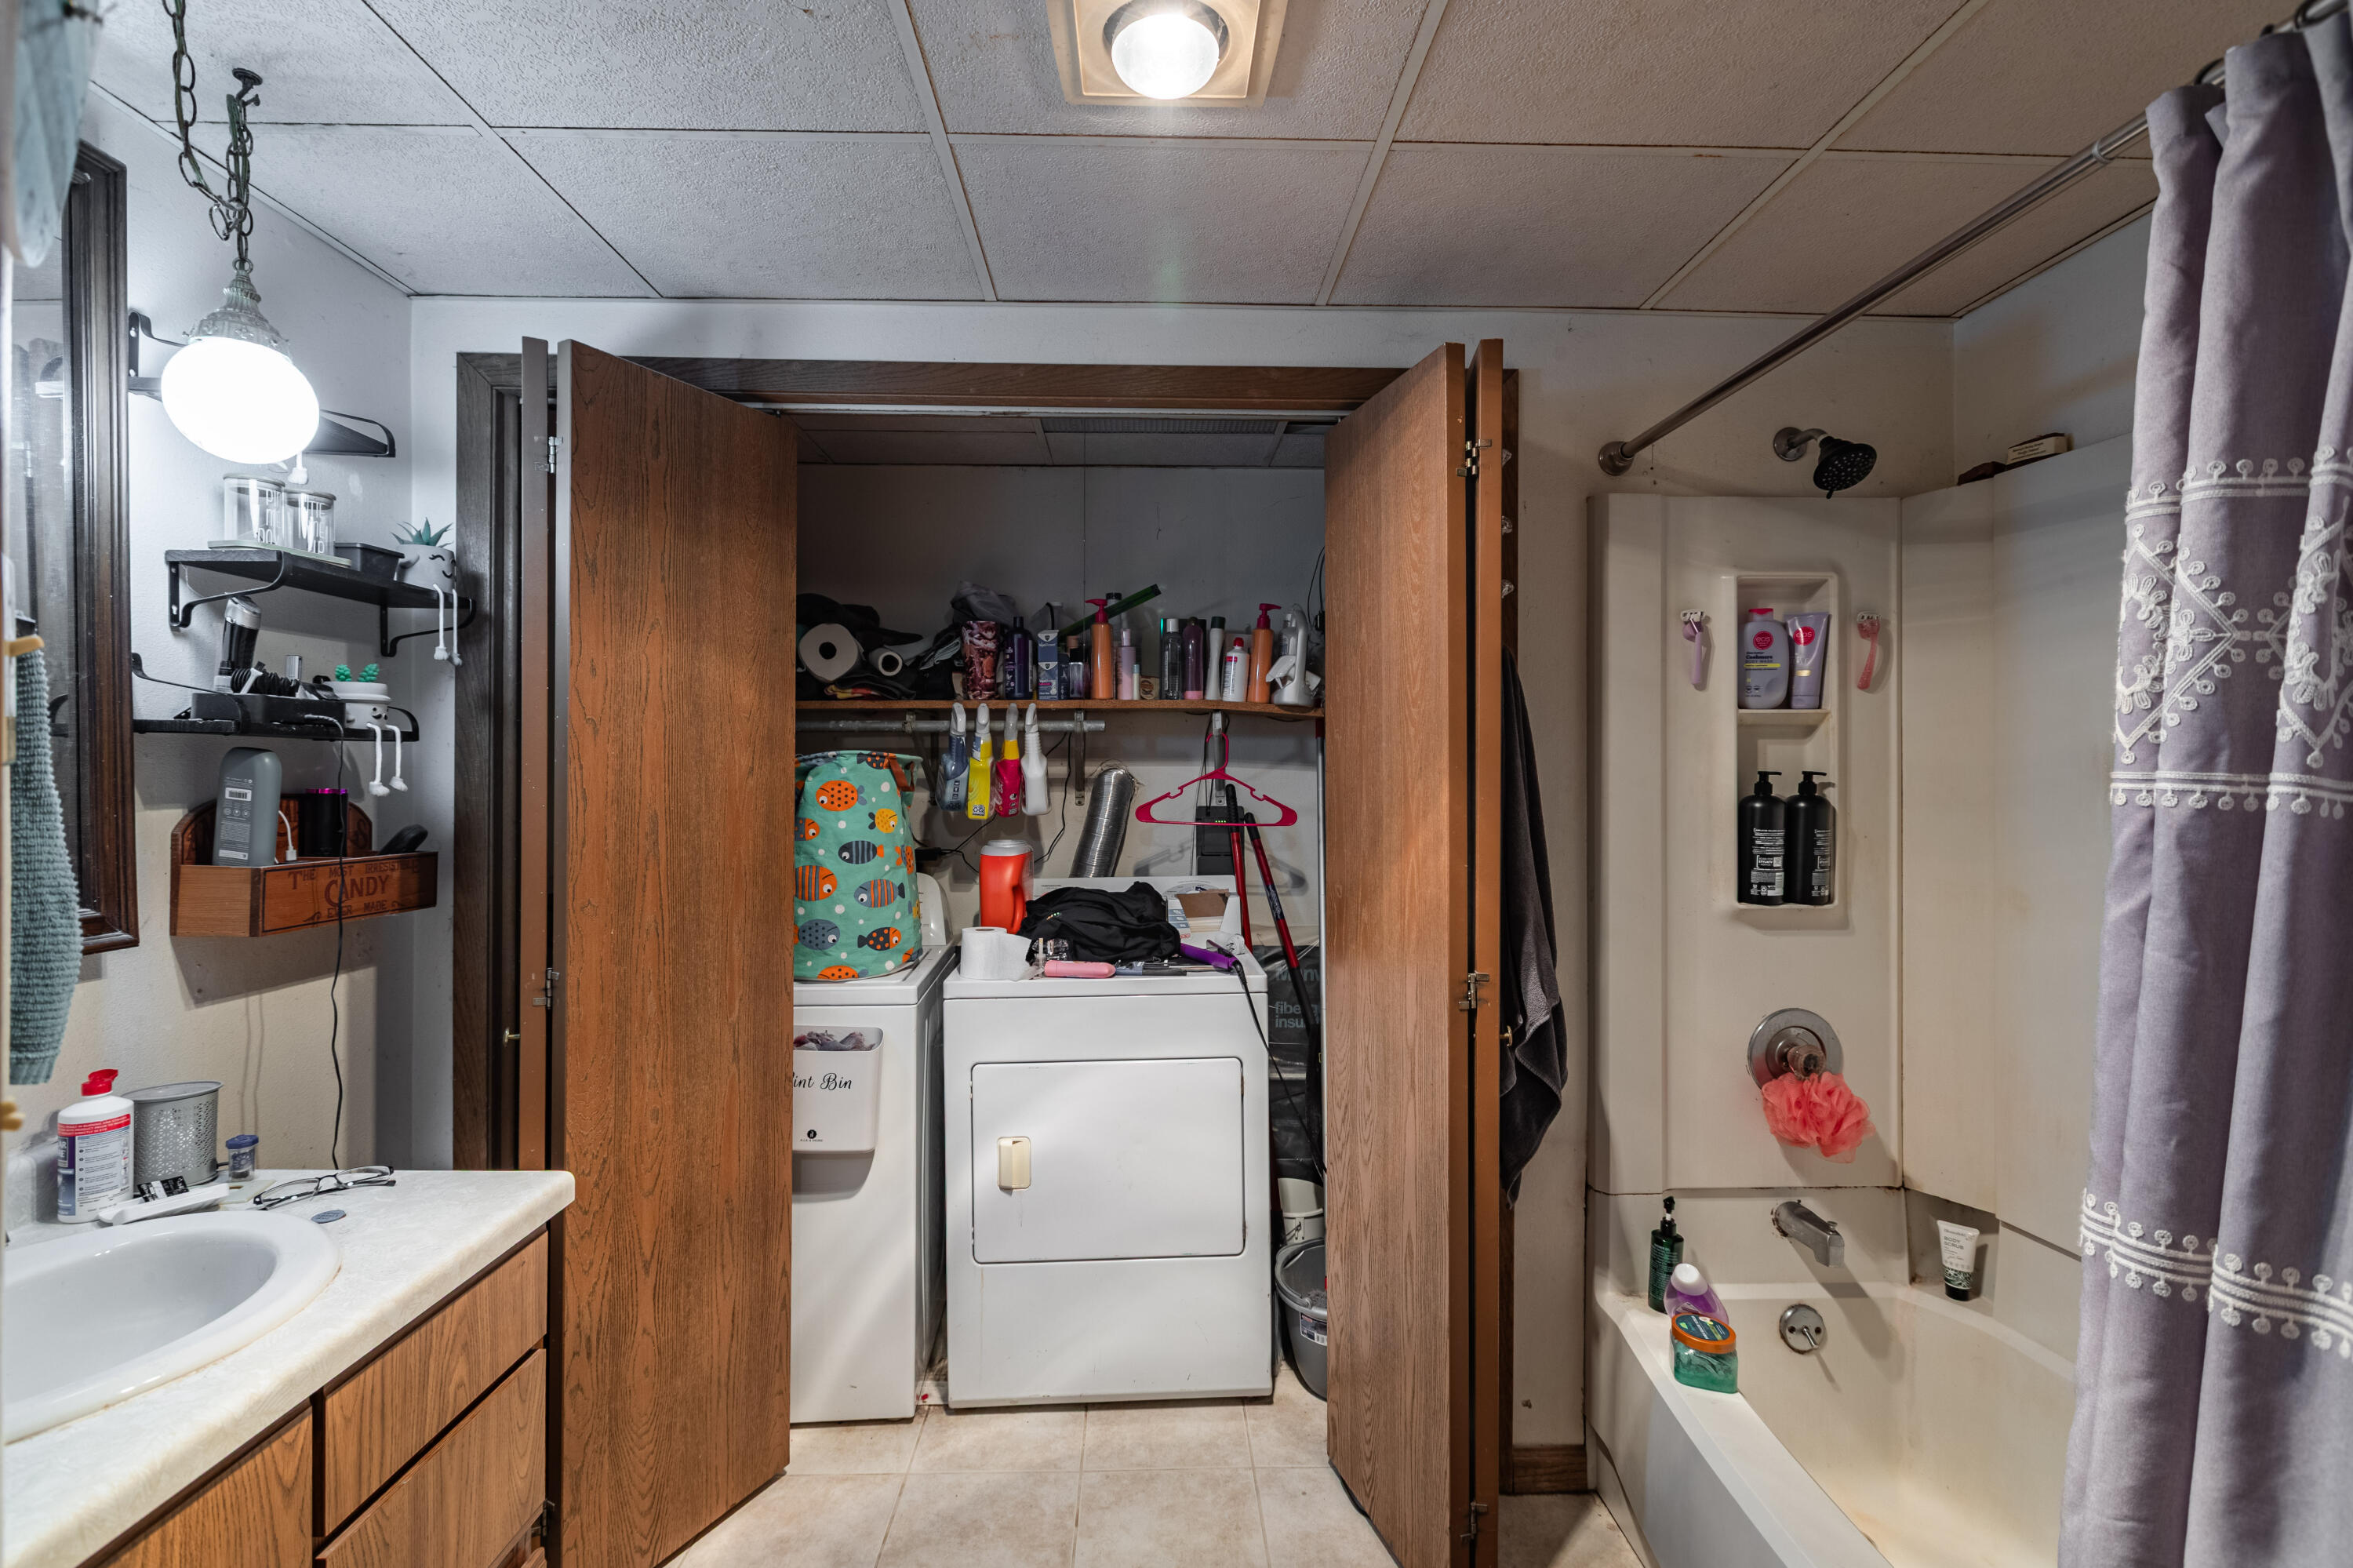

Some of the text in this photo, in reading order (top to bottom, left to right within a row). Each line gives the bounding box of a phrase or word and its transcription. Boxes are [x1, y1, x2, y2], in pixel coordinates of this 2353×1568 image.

[288, 869, 317, 890] THE
[329, 865, 354, 879] MOST
[324, 874, 390, 908] CANDY
[363, 900, 387, 913] MADE
[820, 1072, 853, 1091] Bin
[1944, 1241, 1965, 1250] SCRUB
